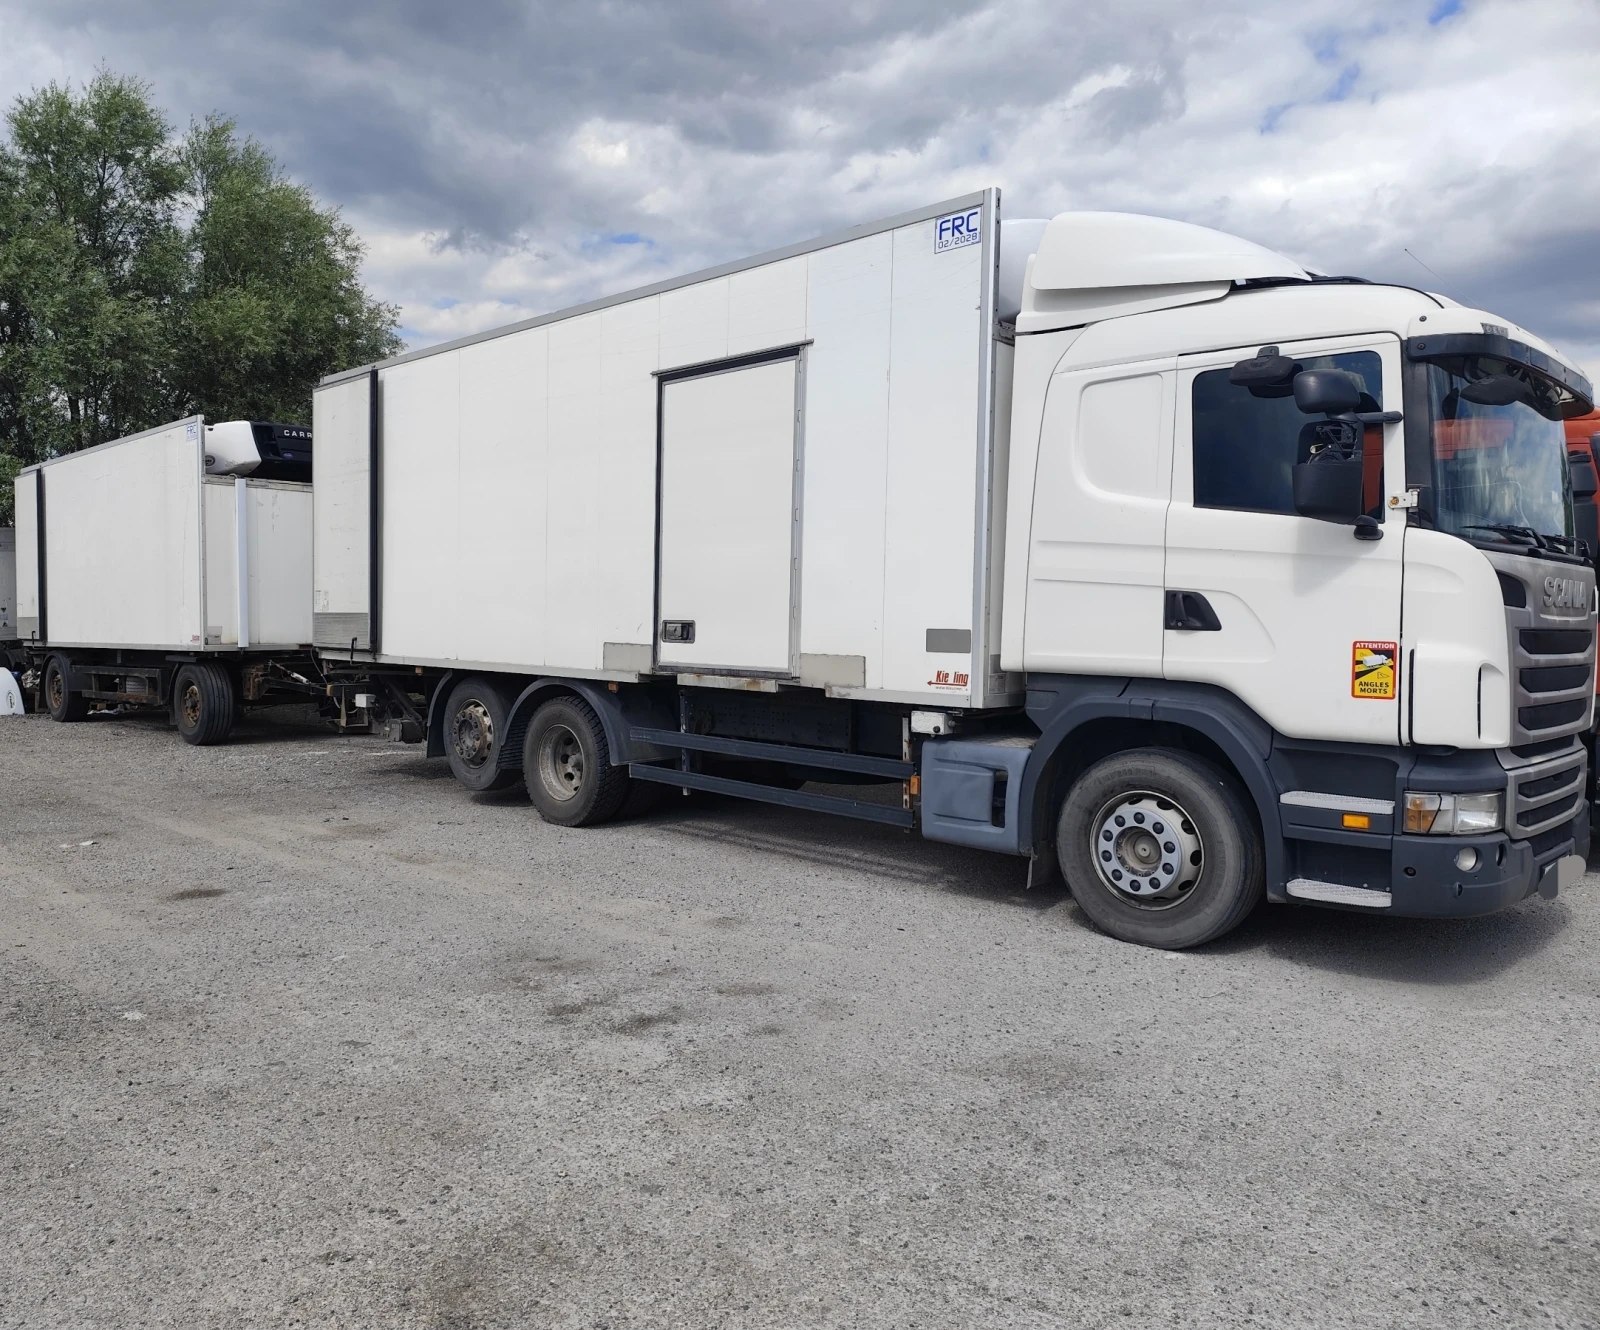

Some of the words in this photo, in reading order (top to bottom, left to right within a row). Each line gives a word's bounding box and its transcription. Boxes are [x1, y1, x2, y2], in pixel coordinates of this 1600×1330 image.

[939, 211, 978, 240] FRC
[938, 232, 977, 249] 02/2028
[1543, 576, 1587, 609] SCANIA
[1359, 687, 1388, 695] MORTS
